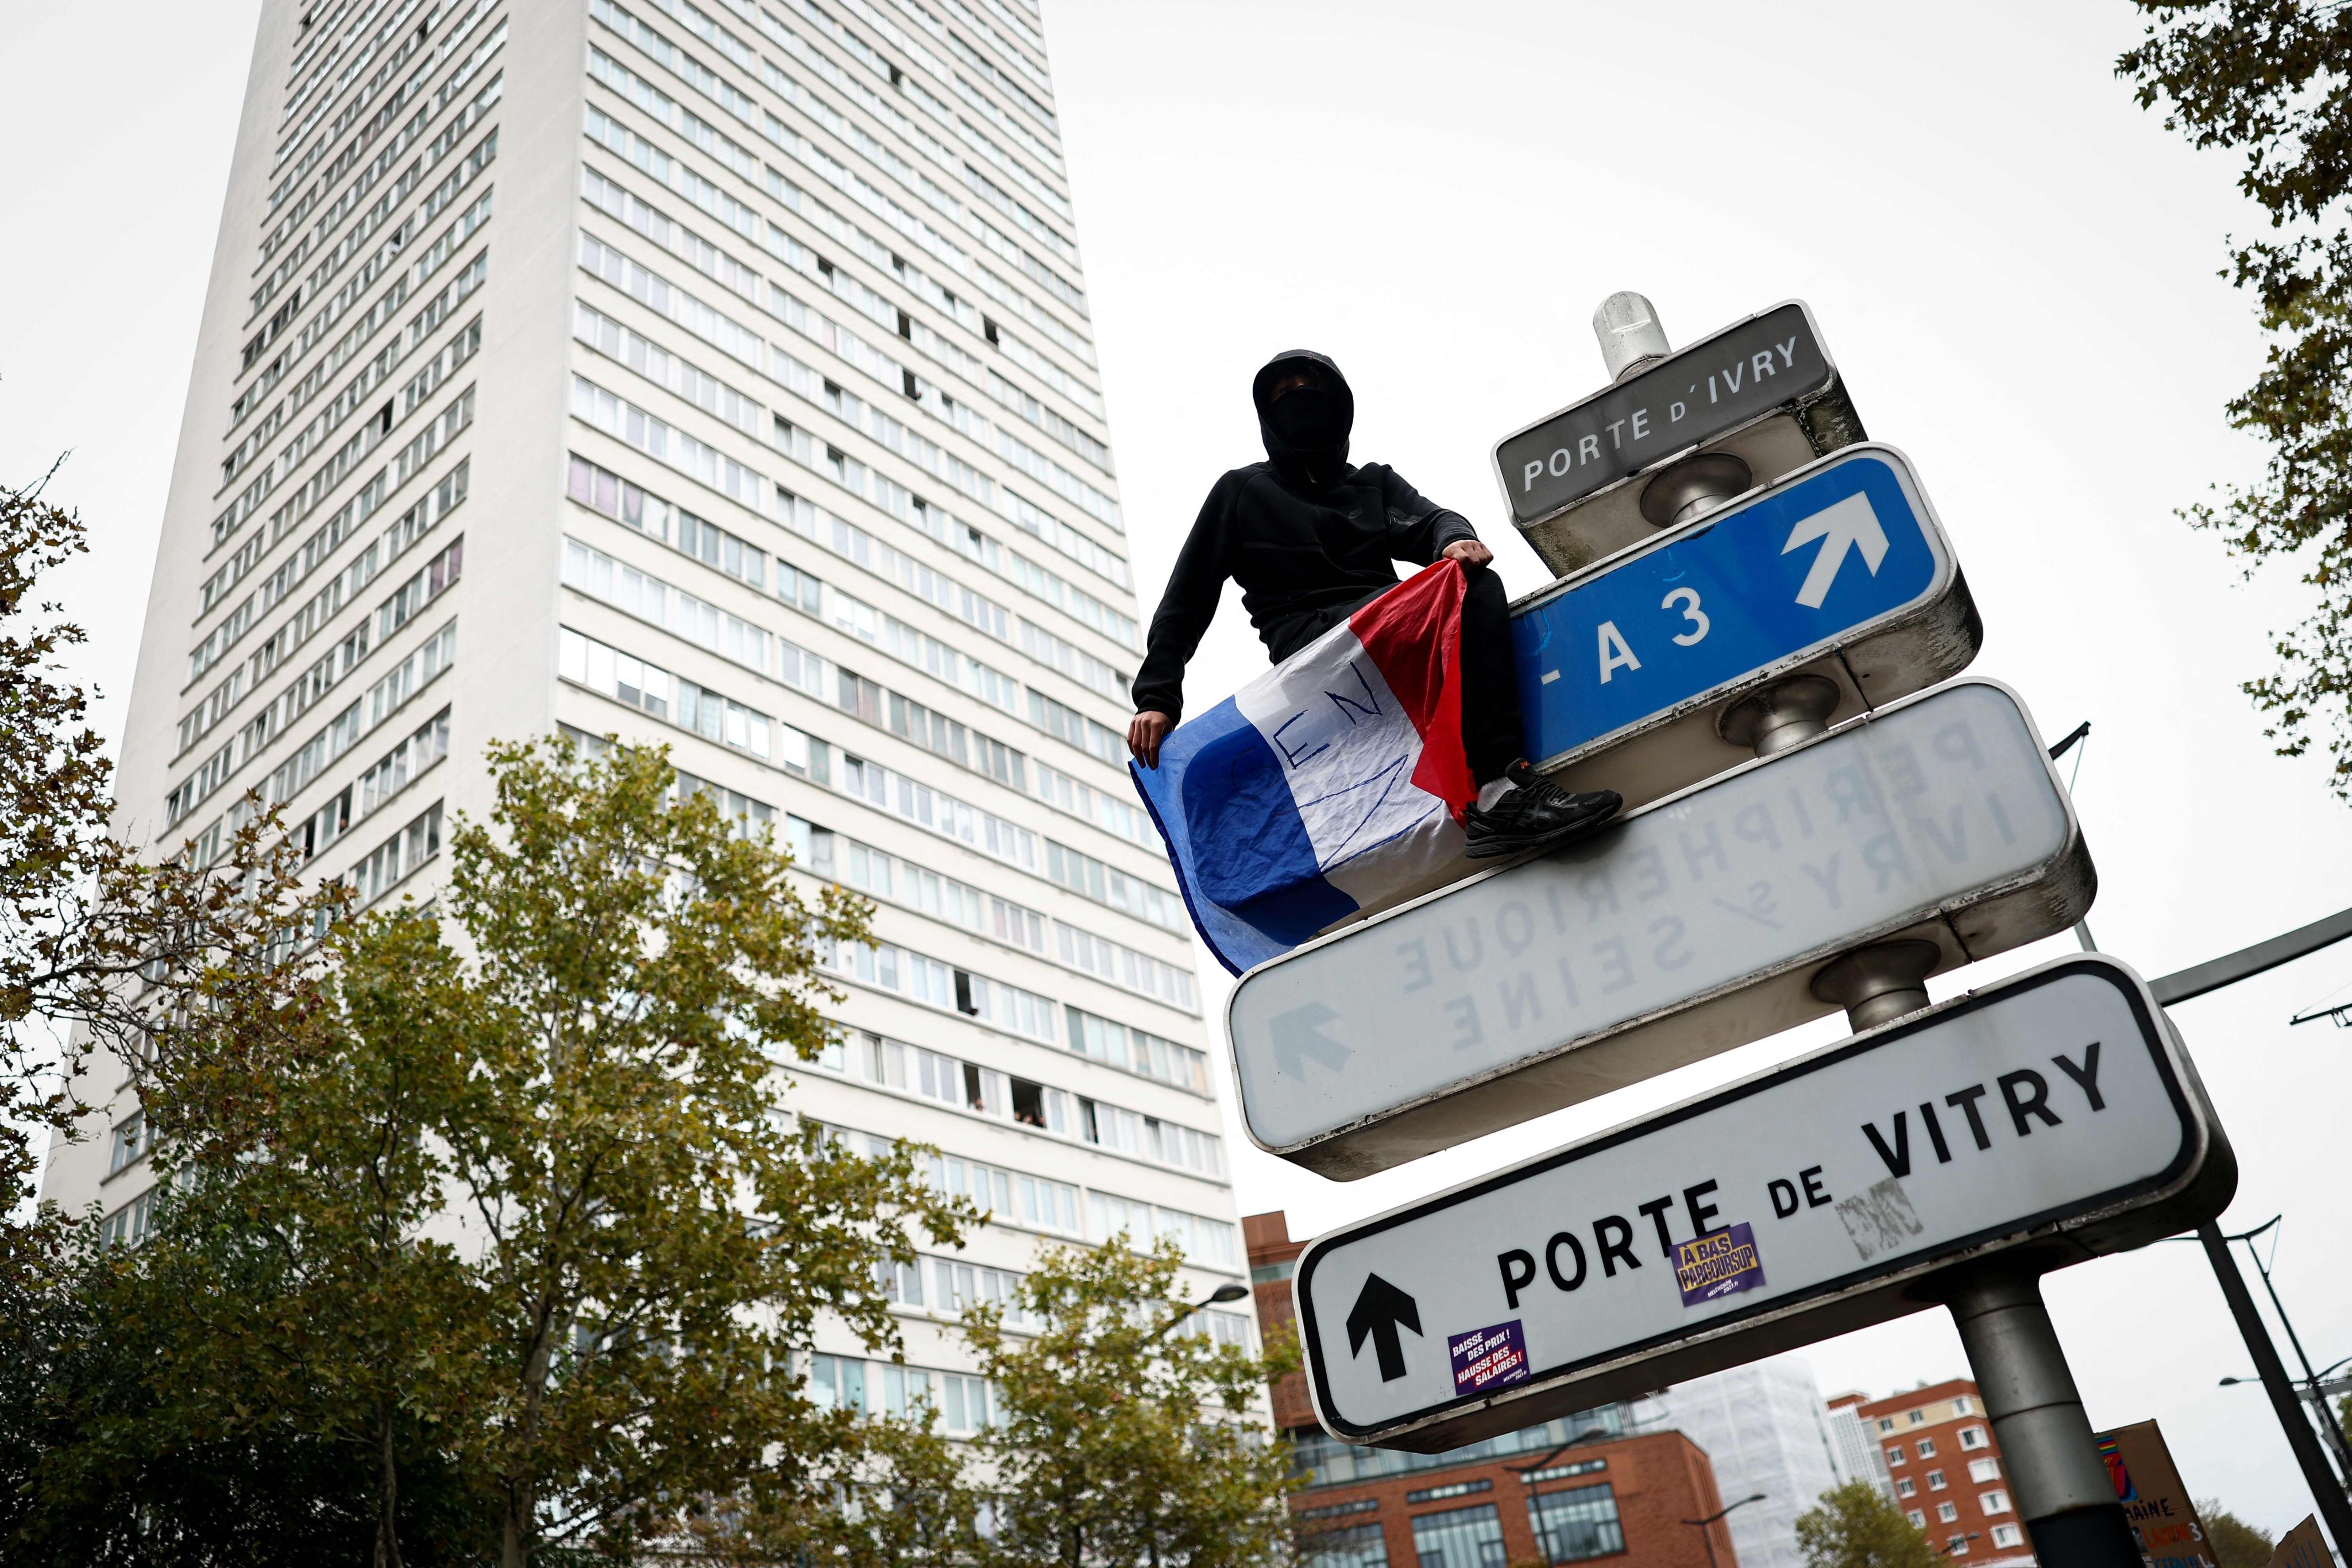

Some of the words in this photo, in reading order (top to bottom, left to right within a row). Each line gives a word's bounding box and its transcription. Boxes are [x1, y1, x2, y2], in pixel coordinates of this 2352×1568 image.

[1524, 408, 1650, 492] PORTE
[1597, 620, 1642, 685] A
[1662, 587, 1710, 646] 3
[1497, 1178, 1731, 1311] PORTE
[1767, 1165, 1833, 1219] DE
[1860, 1041, 2106, 1179] VITRY
[1680, 1246, 1753, 1290] PARCOURSUP
[1696, 1237, 1731, 1261] BAS
[1453, 1331, 1484, 1357] BAISSE
[1467, 1344, 1484, 1362] DES
[1485, 1331, 1506, 1351] PRIX
[1458, 1356, 1492, 1384] HAUSSE
[1492, 1346, 1510, 1364] DES
[1475, 1354, 1518, 1386] SALAIRES
